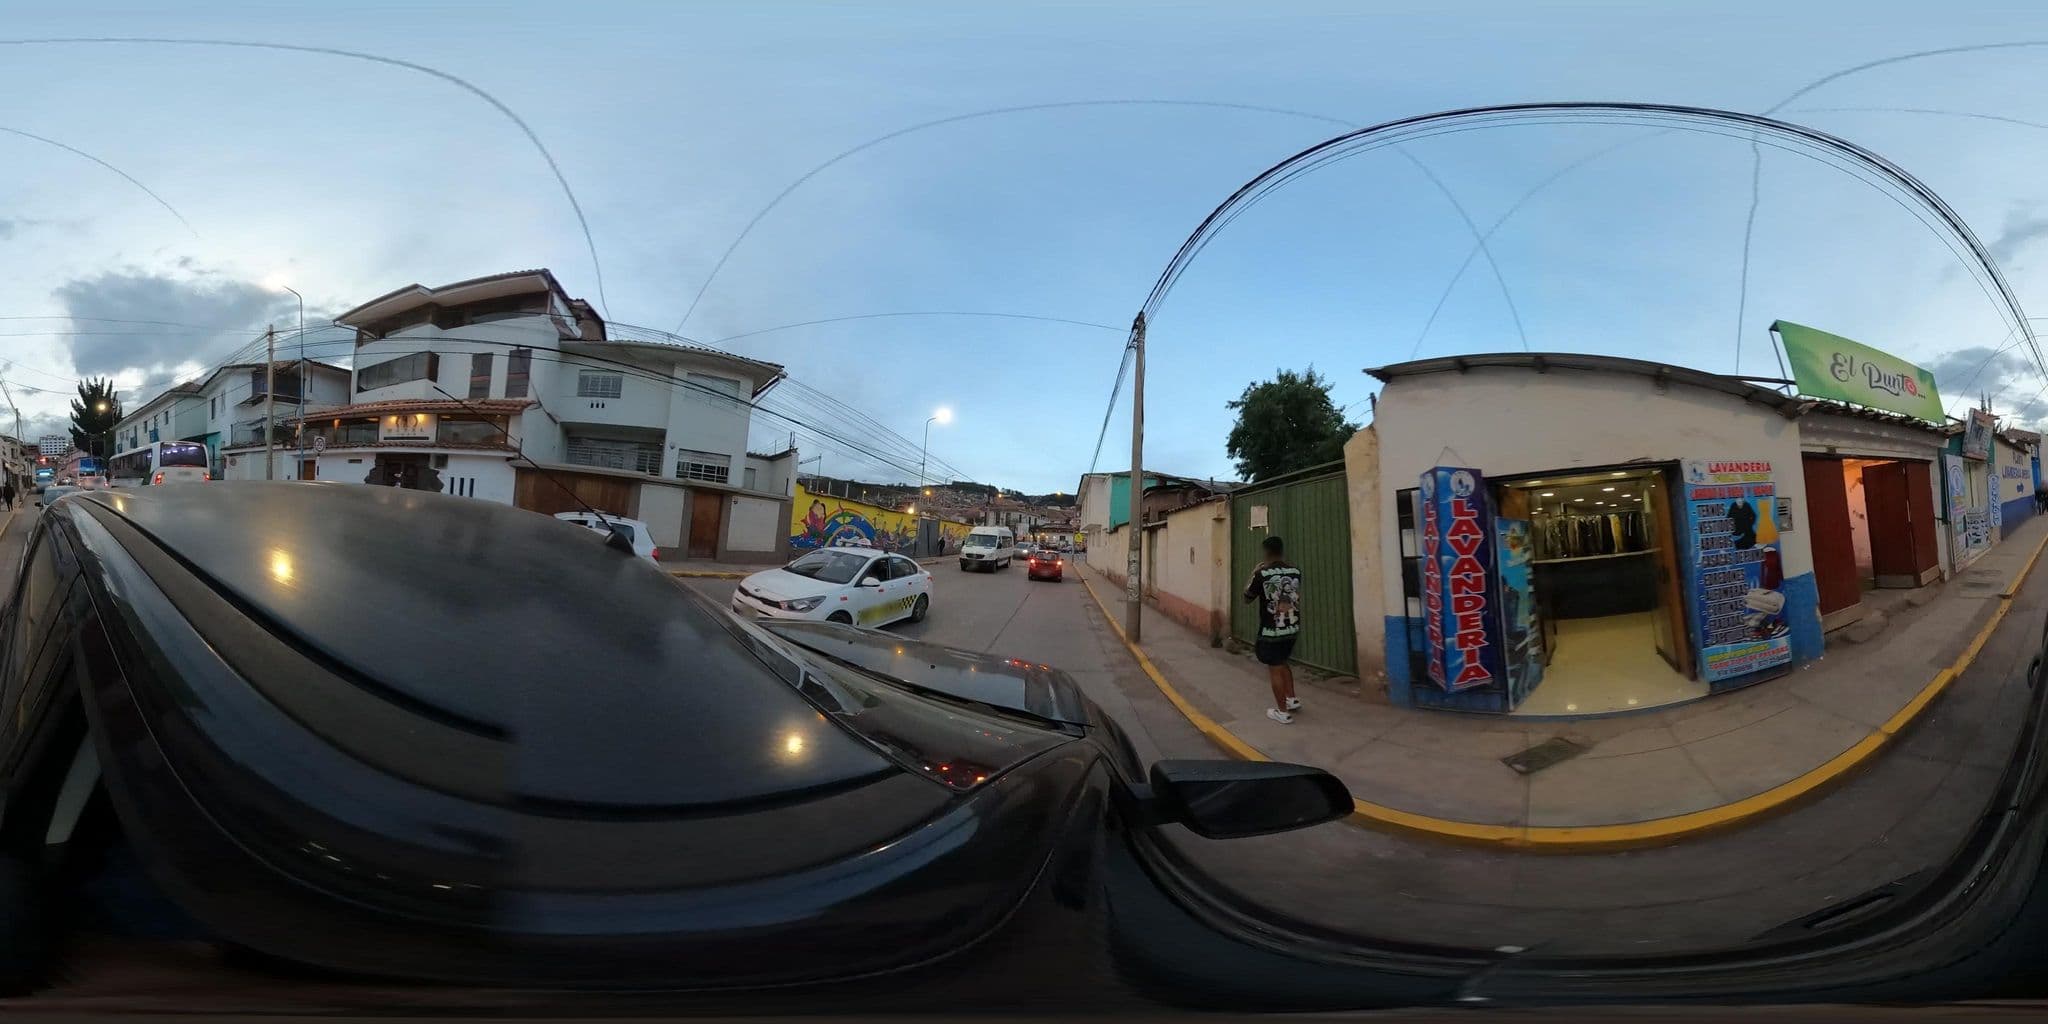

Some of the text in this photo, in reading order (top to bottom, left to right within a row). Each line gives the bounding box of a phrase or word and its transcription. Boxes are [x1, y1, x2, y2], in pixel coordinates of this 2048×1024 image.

[1830, 352, 1856, 382] El
[1708, 462, 1772, 473] LAVANDERIA
[1423, 499, 1446, 689] LAVANDERIA
[1447, 498, 1492, 686] LAVANDERIA
